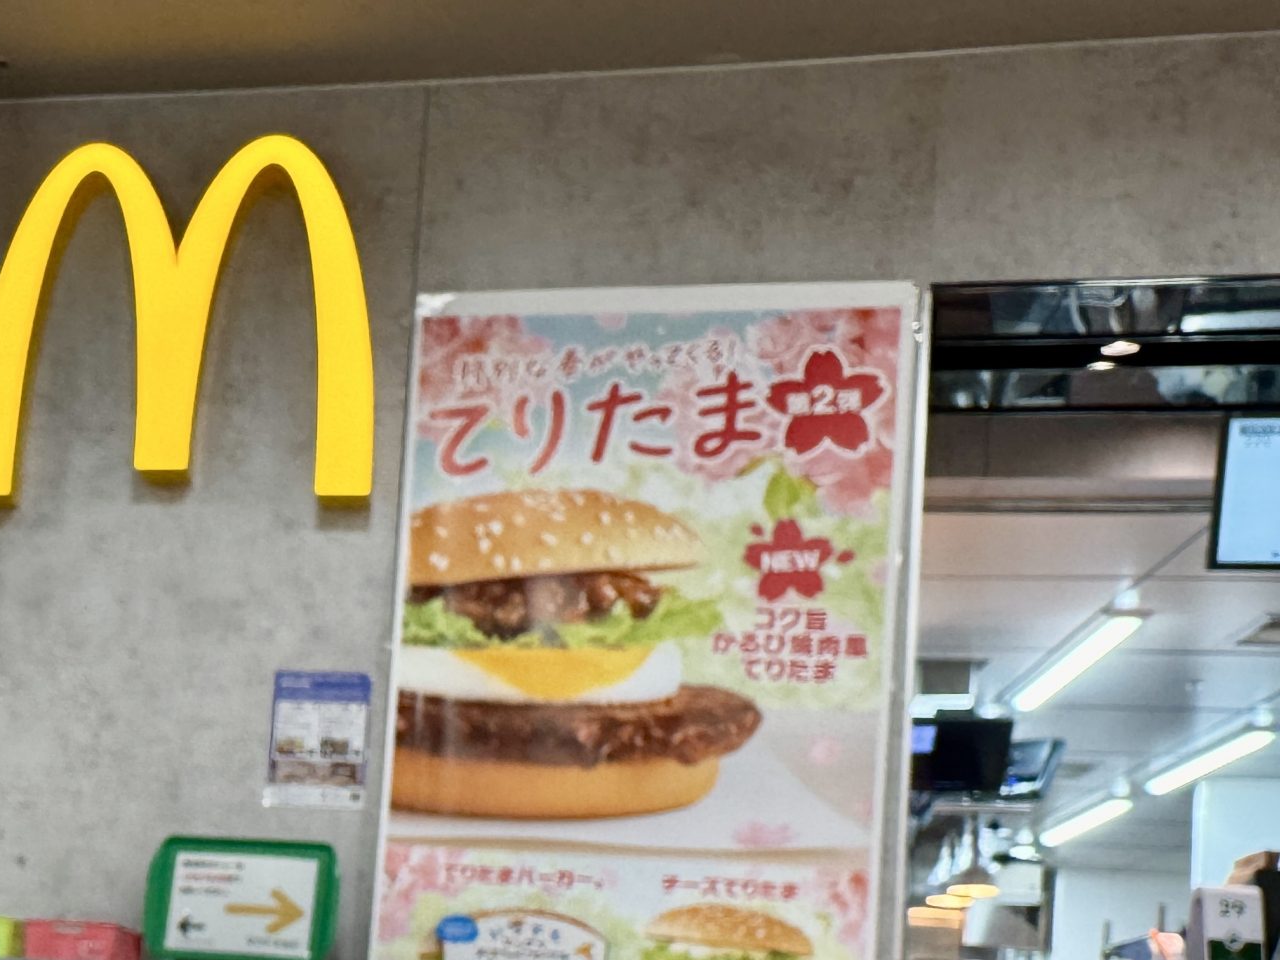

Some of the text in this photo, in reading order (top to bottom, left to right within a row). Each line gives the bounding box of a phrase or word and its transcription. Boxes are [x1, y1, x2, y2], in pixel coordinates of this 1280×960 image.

[430, 372, 762, 476] てりたま
[760, 549, 820, 573] NEW
[744, 658, 835, 683] てりたま
